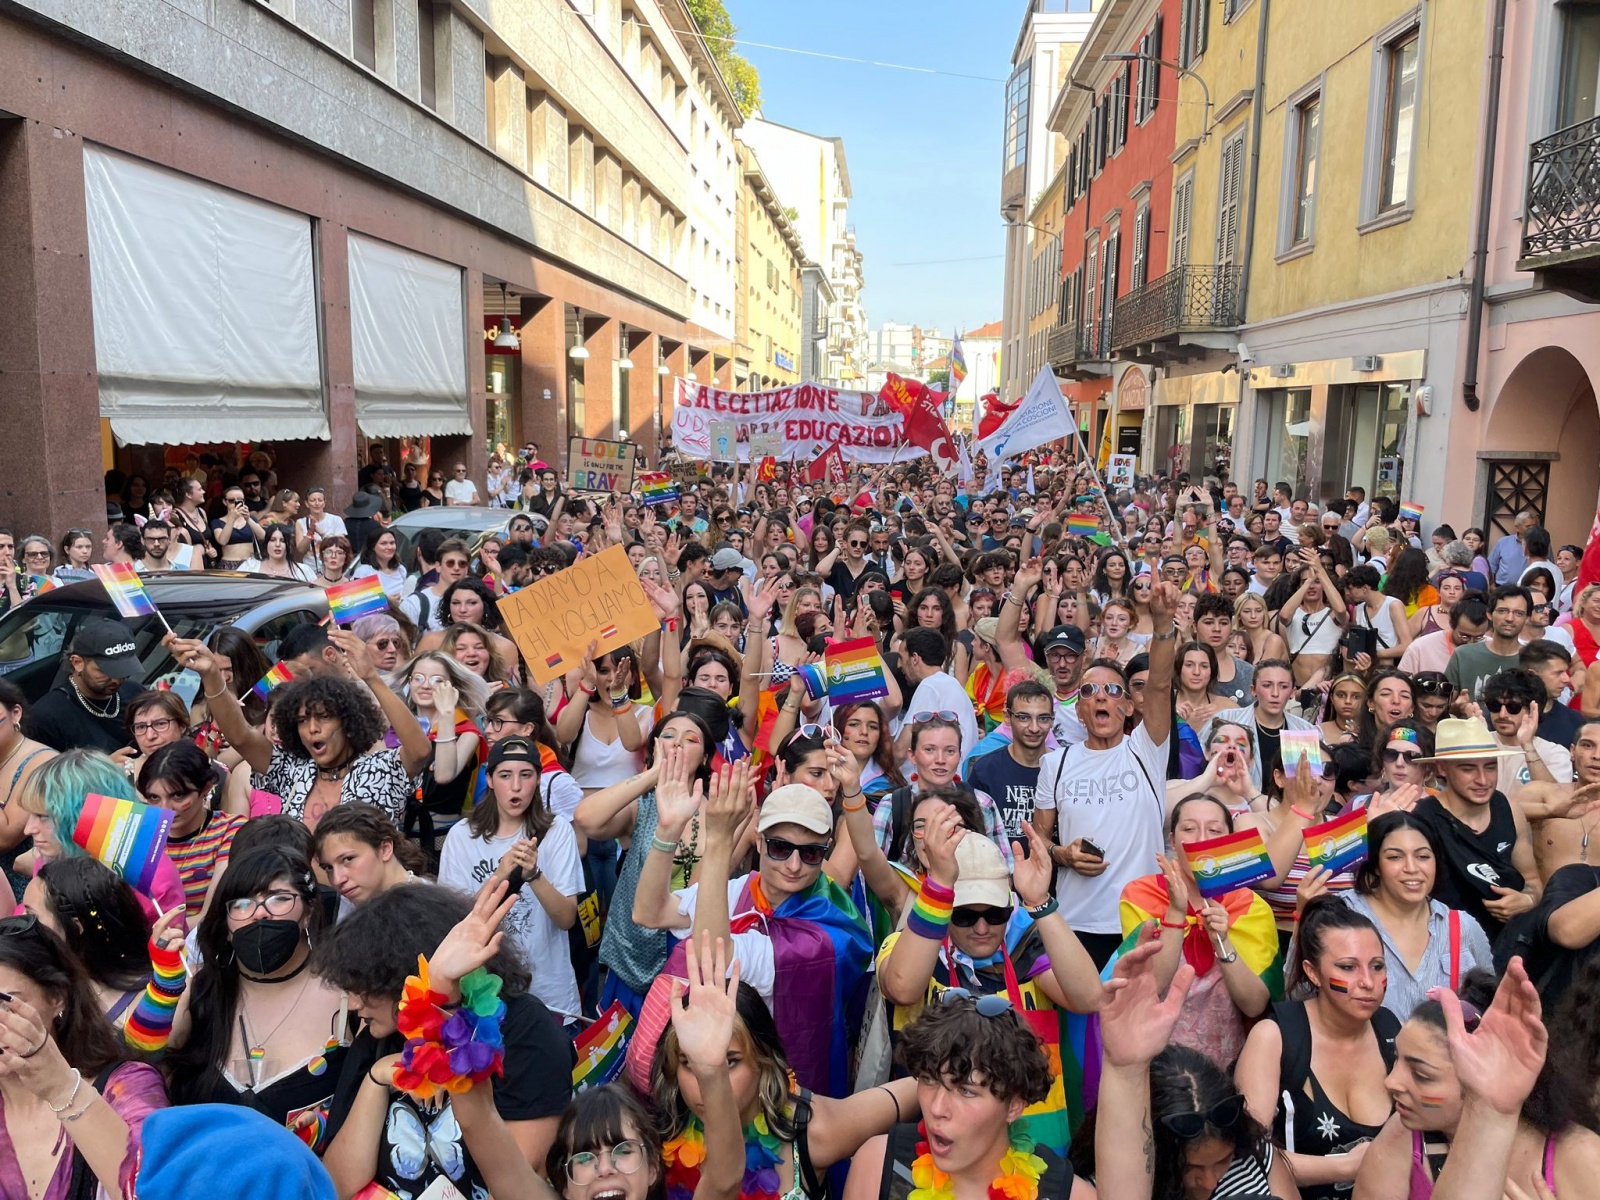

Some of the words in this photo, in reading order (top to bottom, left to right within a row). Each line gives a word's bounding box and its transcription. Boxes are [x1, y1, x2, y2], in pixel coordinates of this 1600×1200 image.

[678, 379, 840, 415] L'ACCETTAZIONE
[581, 440, 627, 459] LOVE
[574, 469, 628, 493] BRAVE
[501, 597, 535, 629] LA
[595, 556, 618, 587] A
[517, 625, 551, 660] CHI
[550, 580, 646, 641] VOGLIAMO
[104, 642, 136, 656] adidas
[1061, 770, 1139, 797] KENZO
[1073, 793, 1124, 805] PARIS
